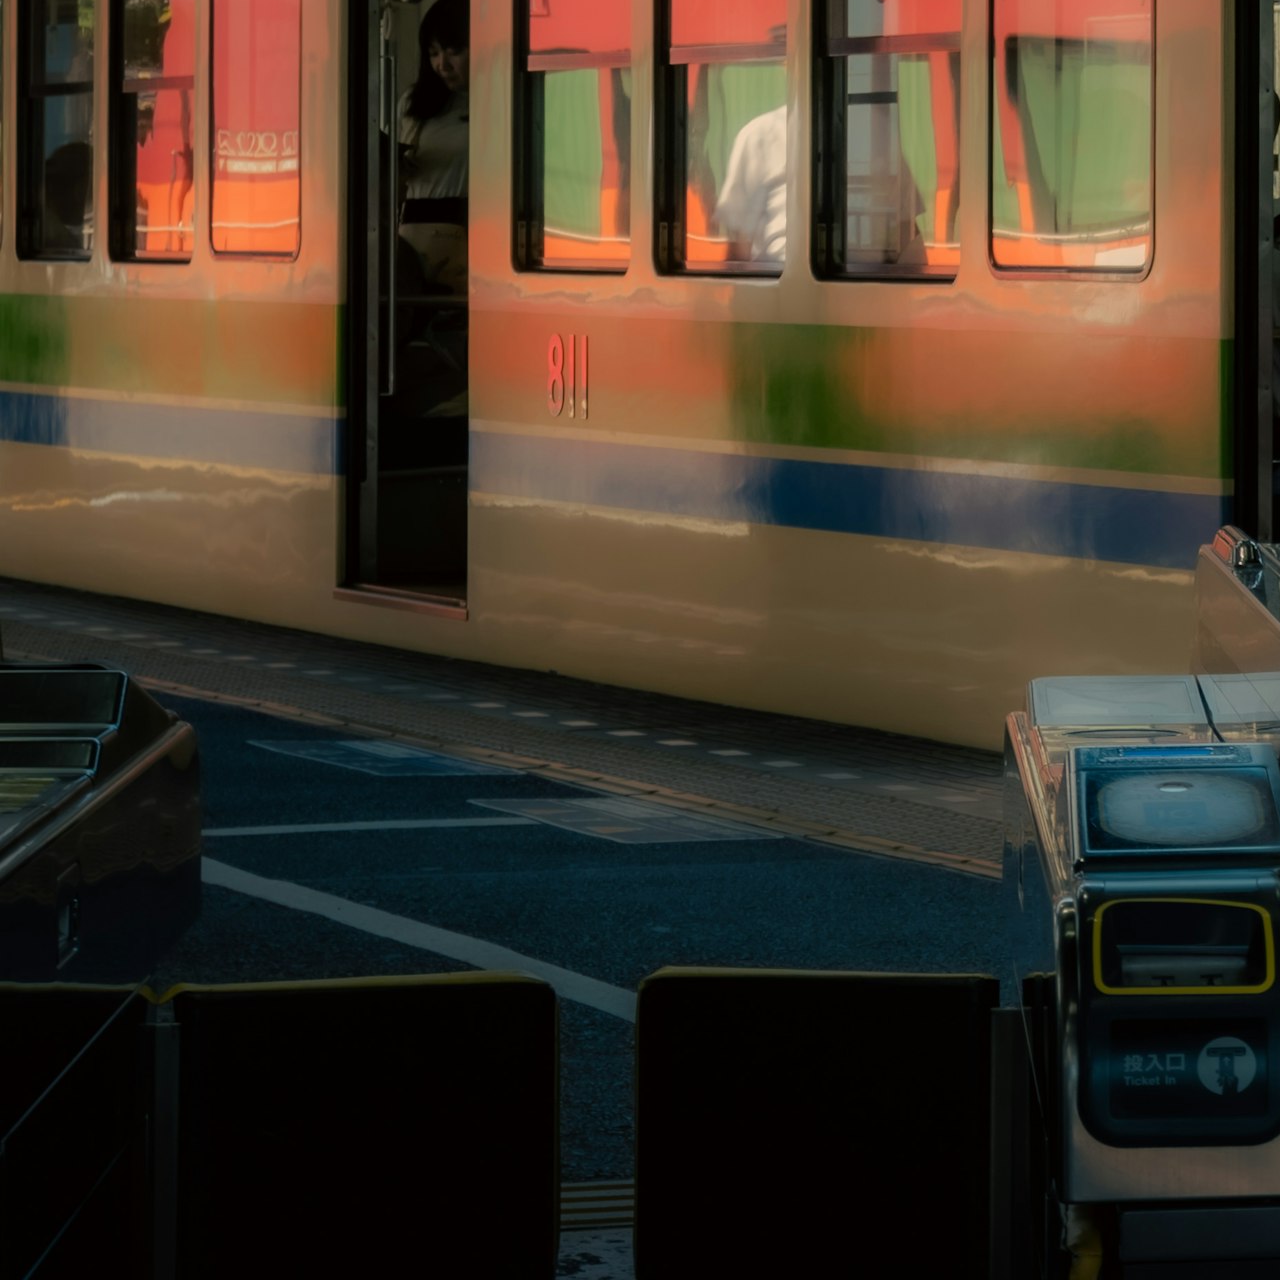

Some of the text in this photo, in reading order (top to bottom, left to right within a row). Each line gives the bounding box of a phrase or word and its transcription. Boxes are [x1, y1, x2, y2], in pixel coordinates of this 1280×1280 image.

[547, 332, 589, 420] 811
[1123, 1053, 1186, 1072] 投入口
[1124, 1075, 1177, 1086] Ticket In
